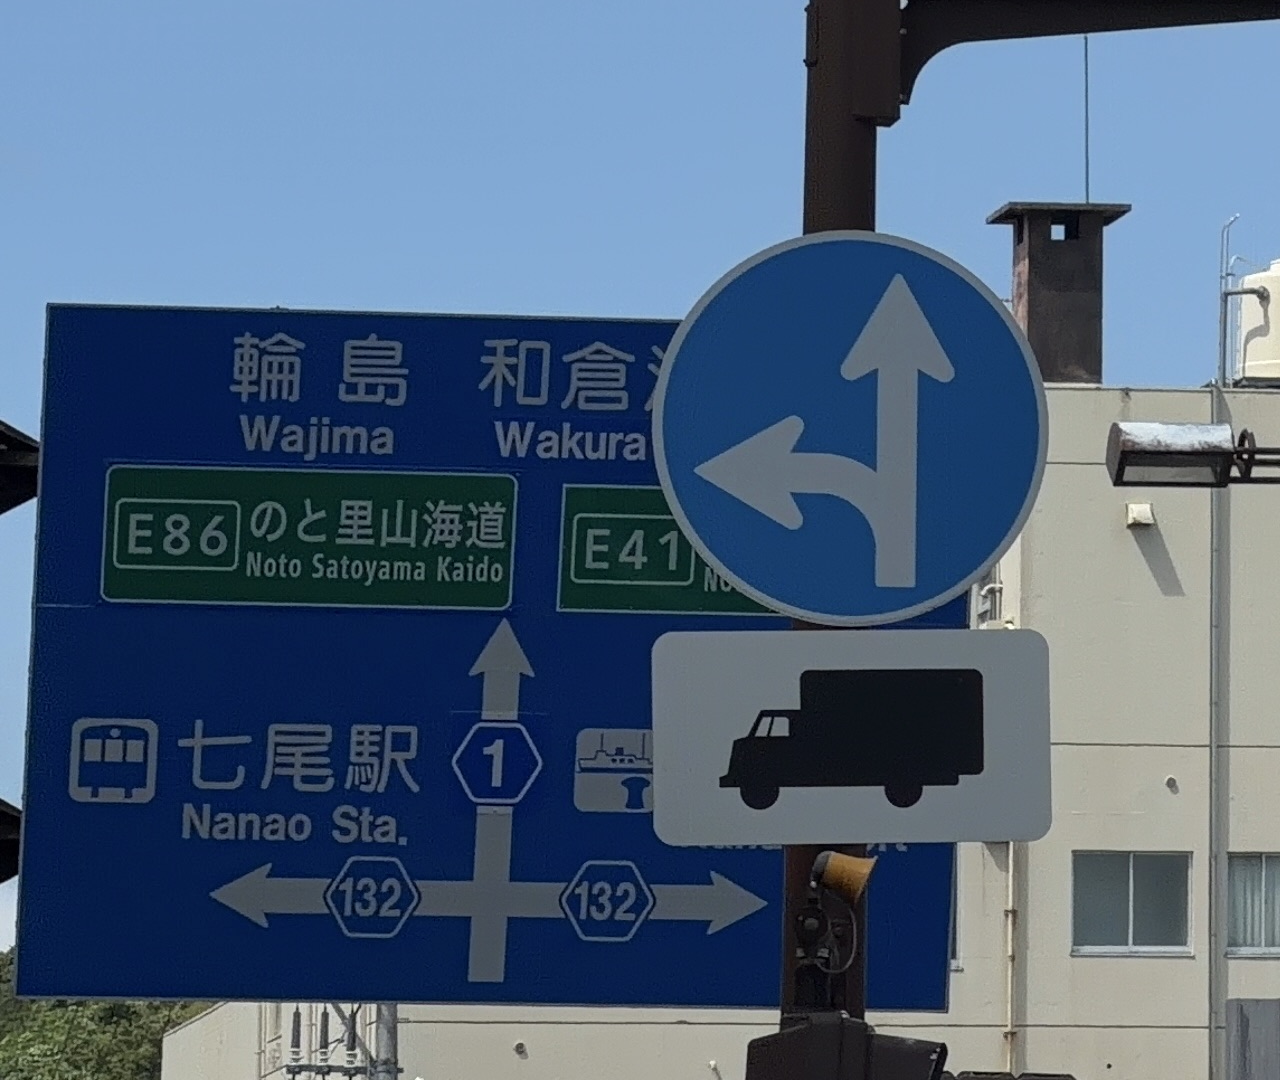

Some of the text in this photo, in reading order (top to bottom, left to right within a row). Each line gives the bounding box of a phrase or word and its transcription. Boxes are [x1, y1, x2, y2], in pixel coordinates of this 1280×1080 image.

[230, 332, 408, 407] 輪島
[478, 338, 666, 411] 和倉
[239, 414, 394, 461] Wajima
[494, 421, 646, 461] Wakura
[127, 513, 229, 557] E86
[250, 498, 507, 549] のと里山海道
[246, 551, 503, 586] Noto Satoyama Kaido
[584, 528, 679, 571] E41
[177, 719, 420, 793] 七尾駅
[482, 738, 504, 788] 1
[181, 803, 408, 846] Nanao Sta.
[338, 876, 402, 918] 132
[574, 880, 637, 921] 132
